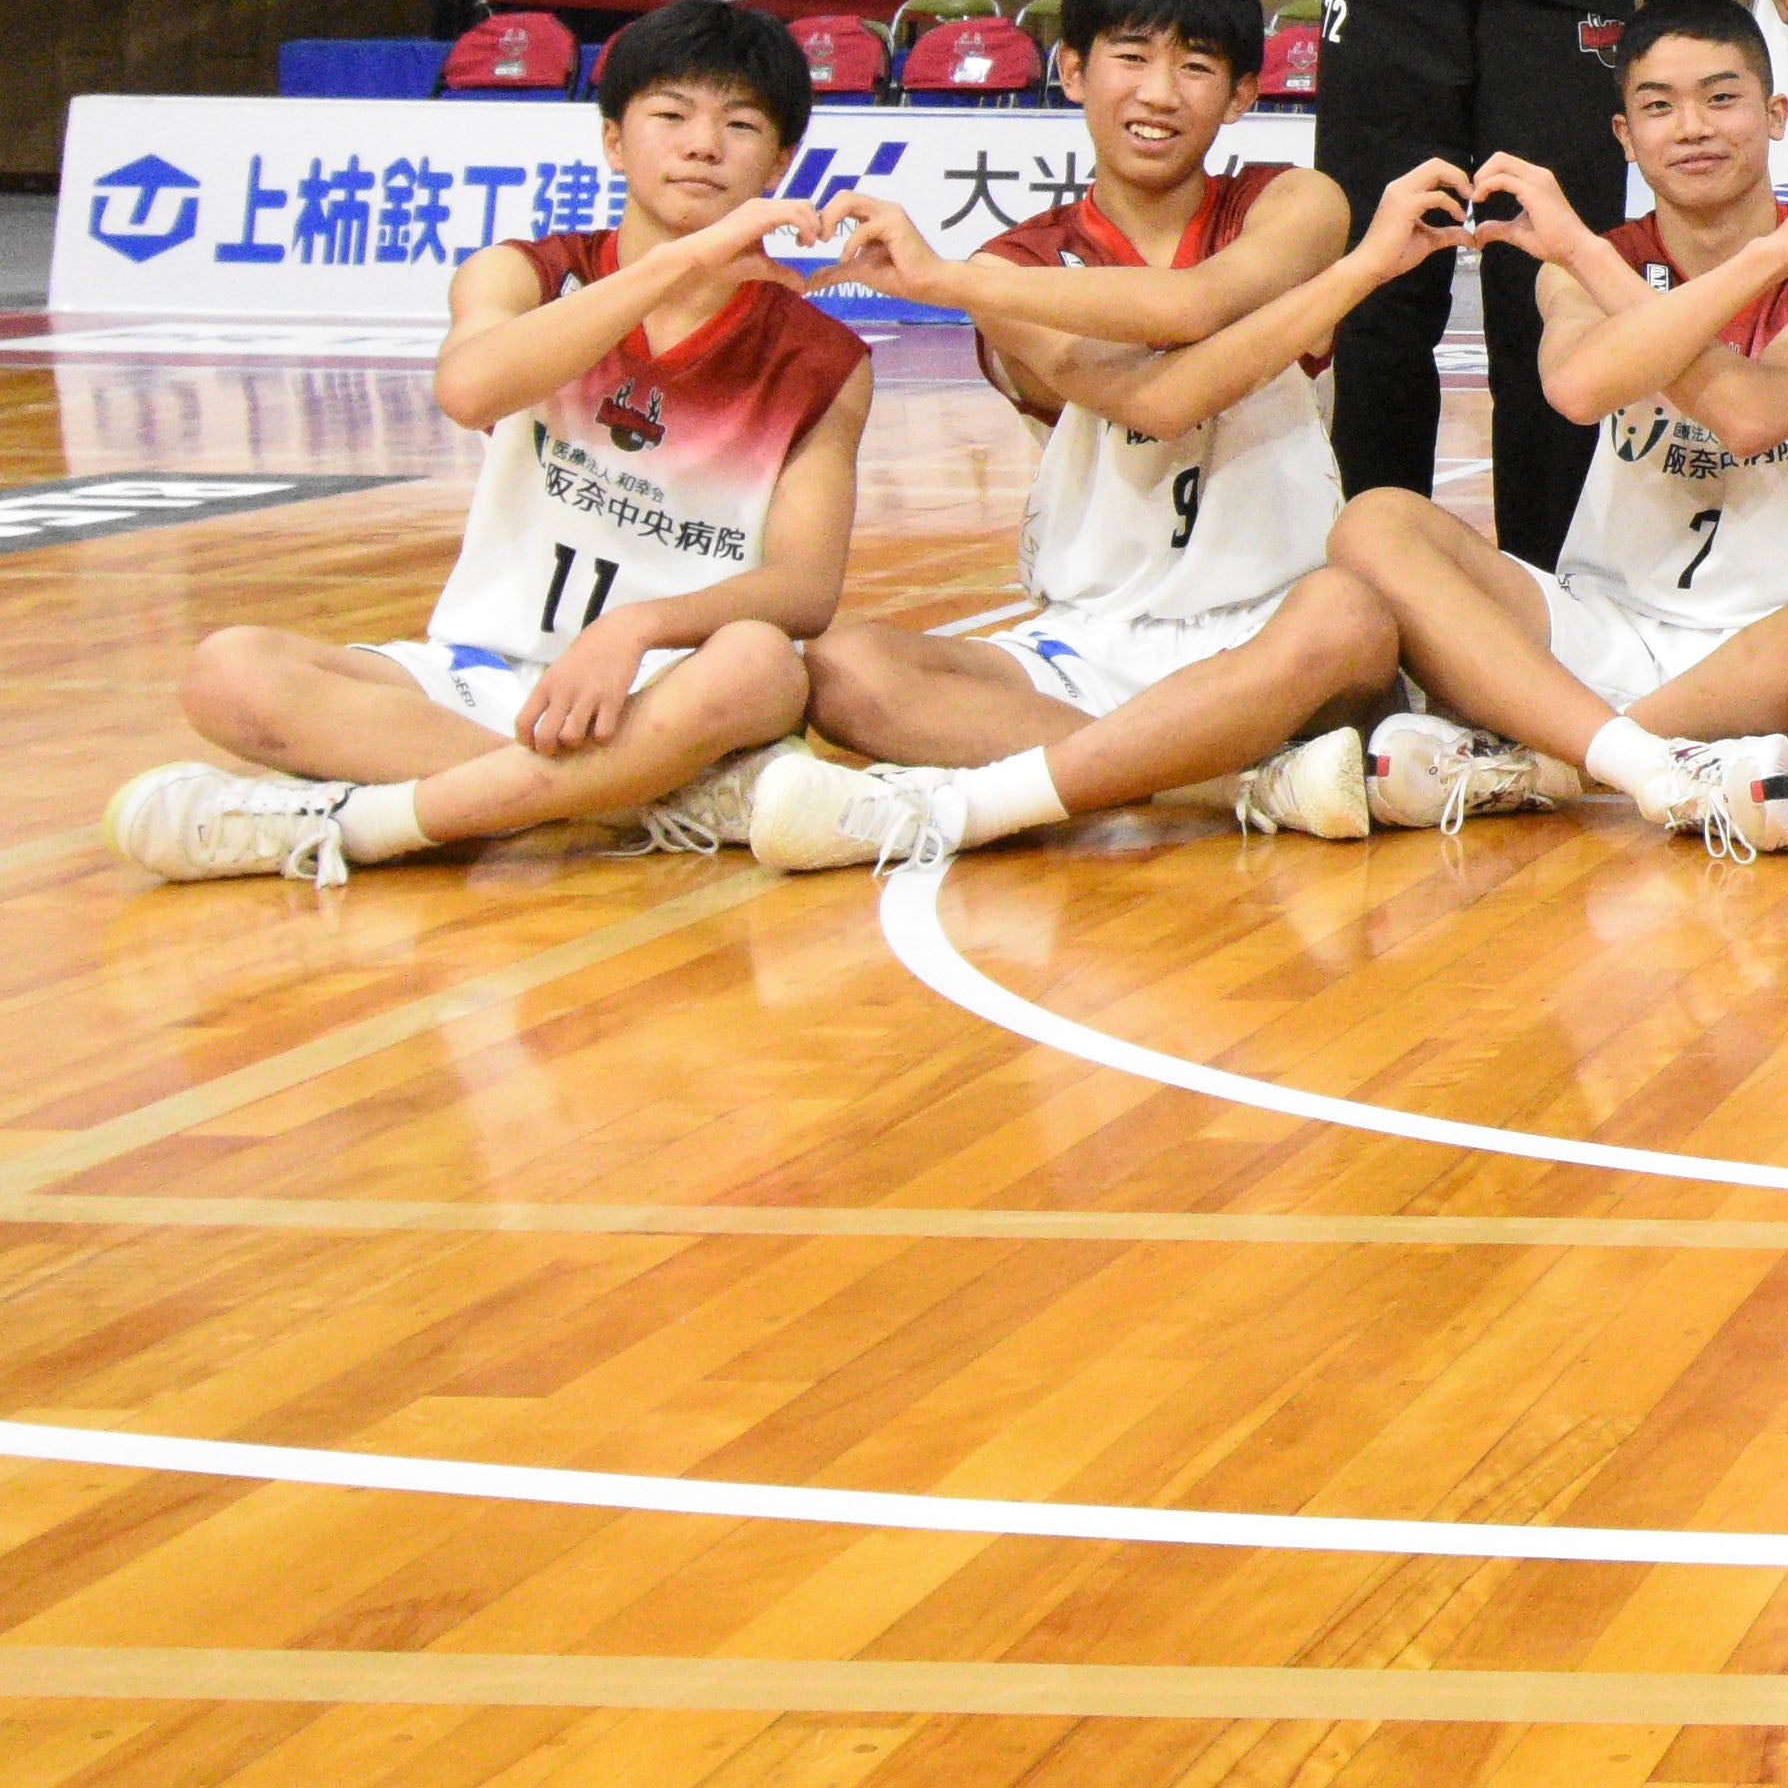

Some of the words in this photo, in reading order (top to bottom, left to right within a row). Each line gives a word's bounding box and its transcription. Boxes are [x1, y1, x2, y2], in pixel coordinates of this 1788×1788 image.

[215, 153, 625, 266] 上柿鉄工建
[546, 462, 746, 562] 阪奈中央病院
[1677, 509, 1724, 589] 7
[541, 541, 620, 633] 11
